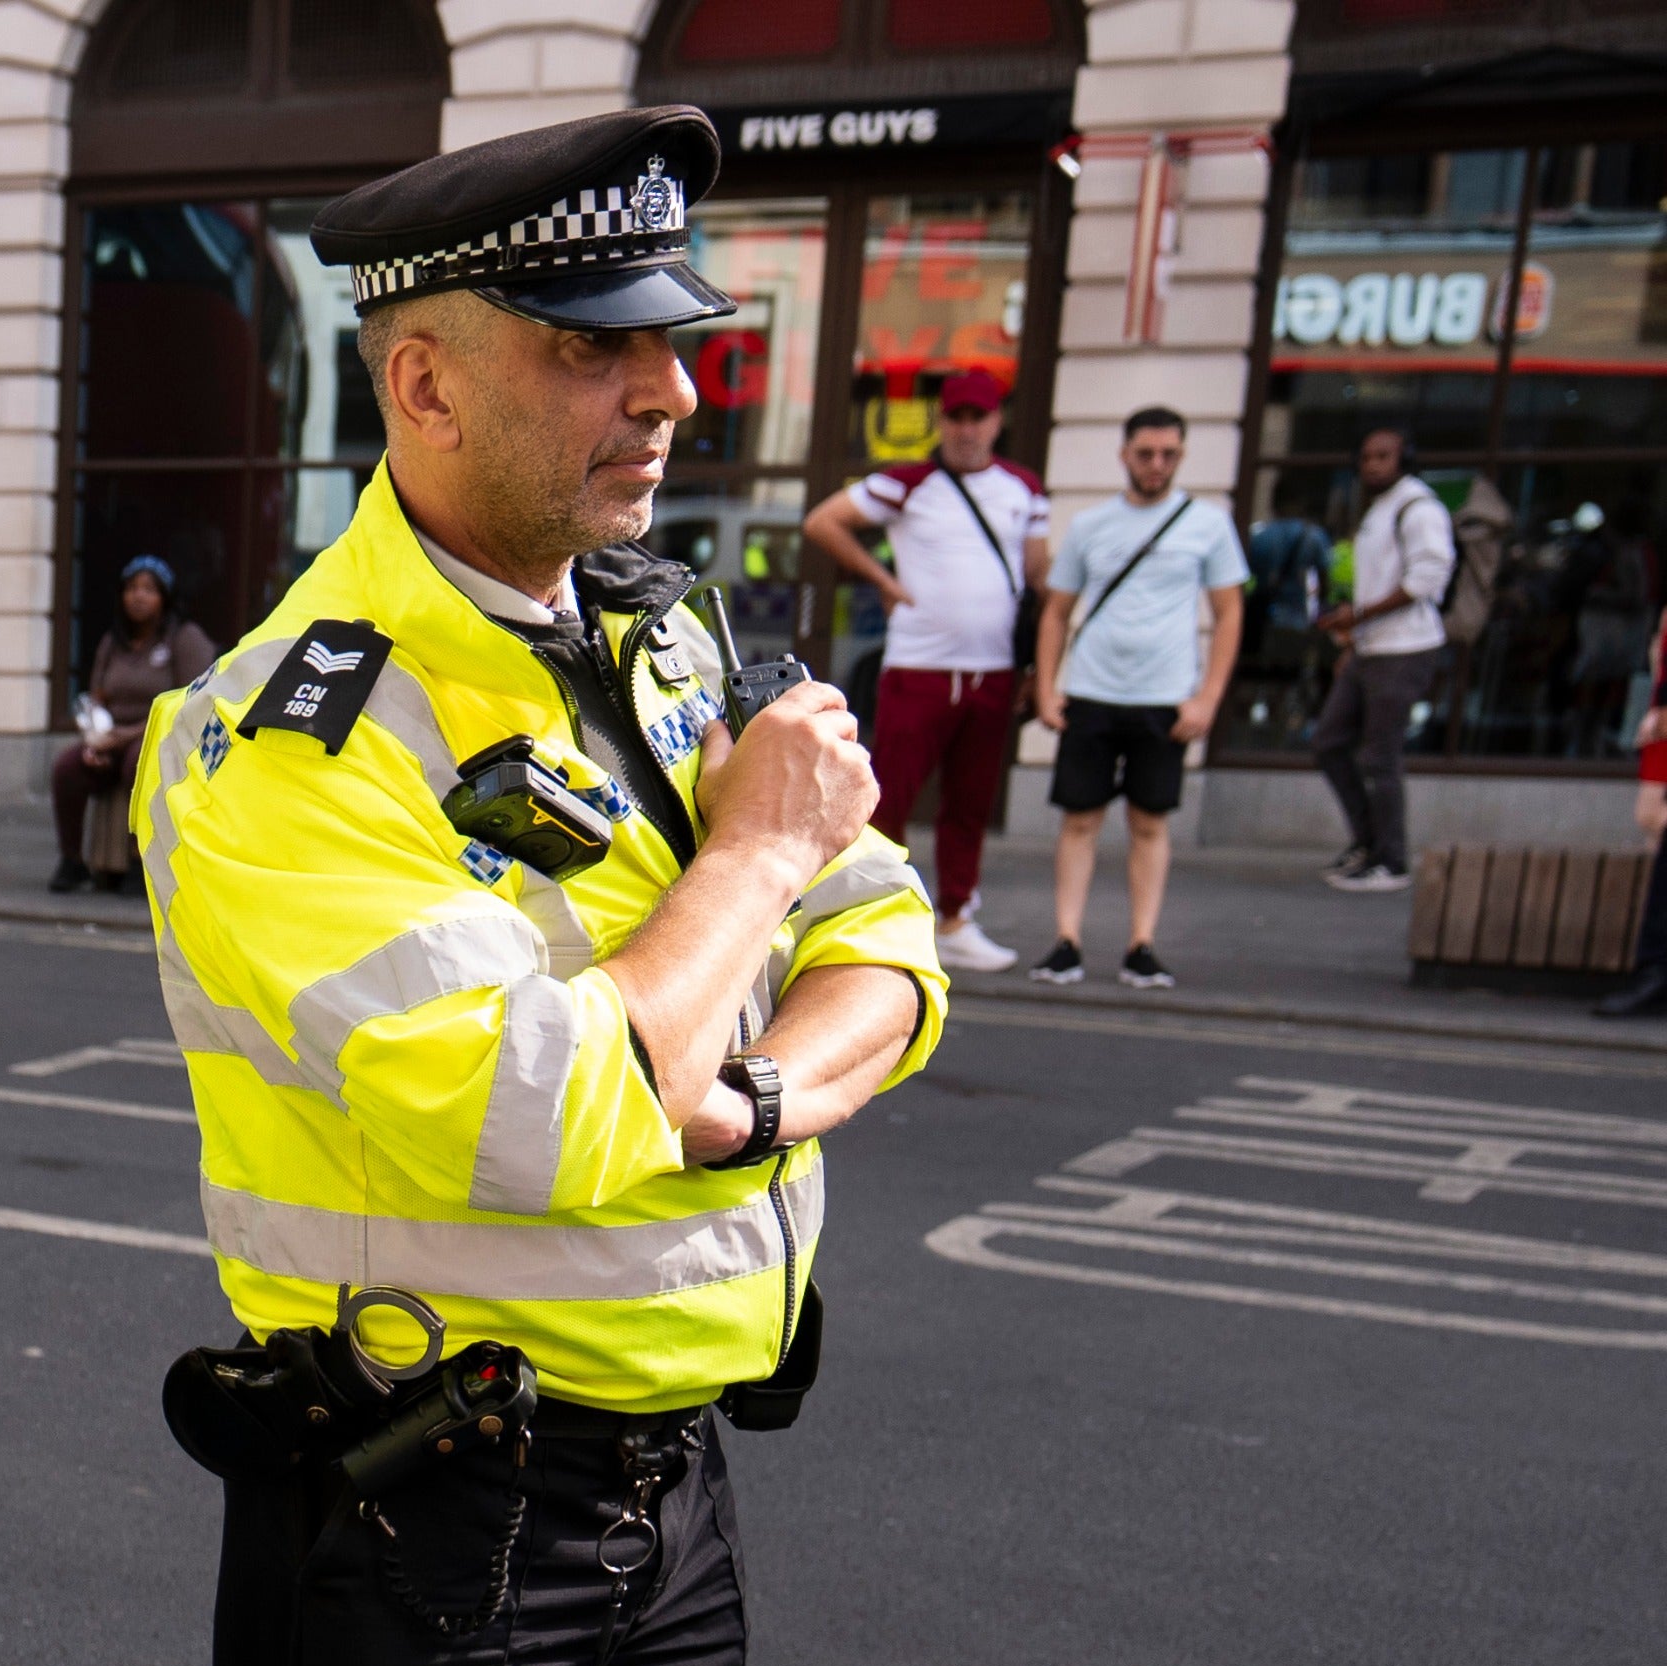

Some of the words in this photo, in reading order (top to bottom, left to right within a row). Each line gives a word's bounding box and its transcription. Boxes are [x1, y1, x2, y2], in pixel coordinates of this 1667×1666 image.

[739, 113, 824, 151] FIVE
[829, 107, 939, 146] GUYS
[294, 683, 329, 702] CN
[283, 700, 319, 718] 189
